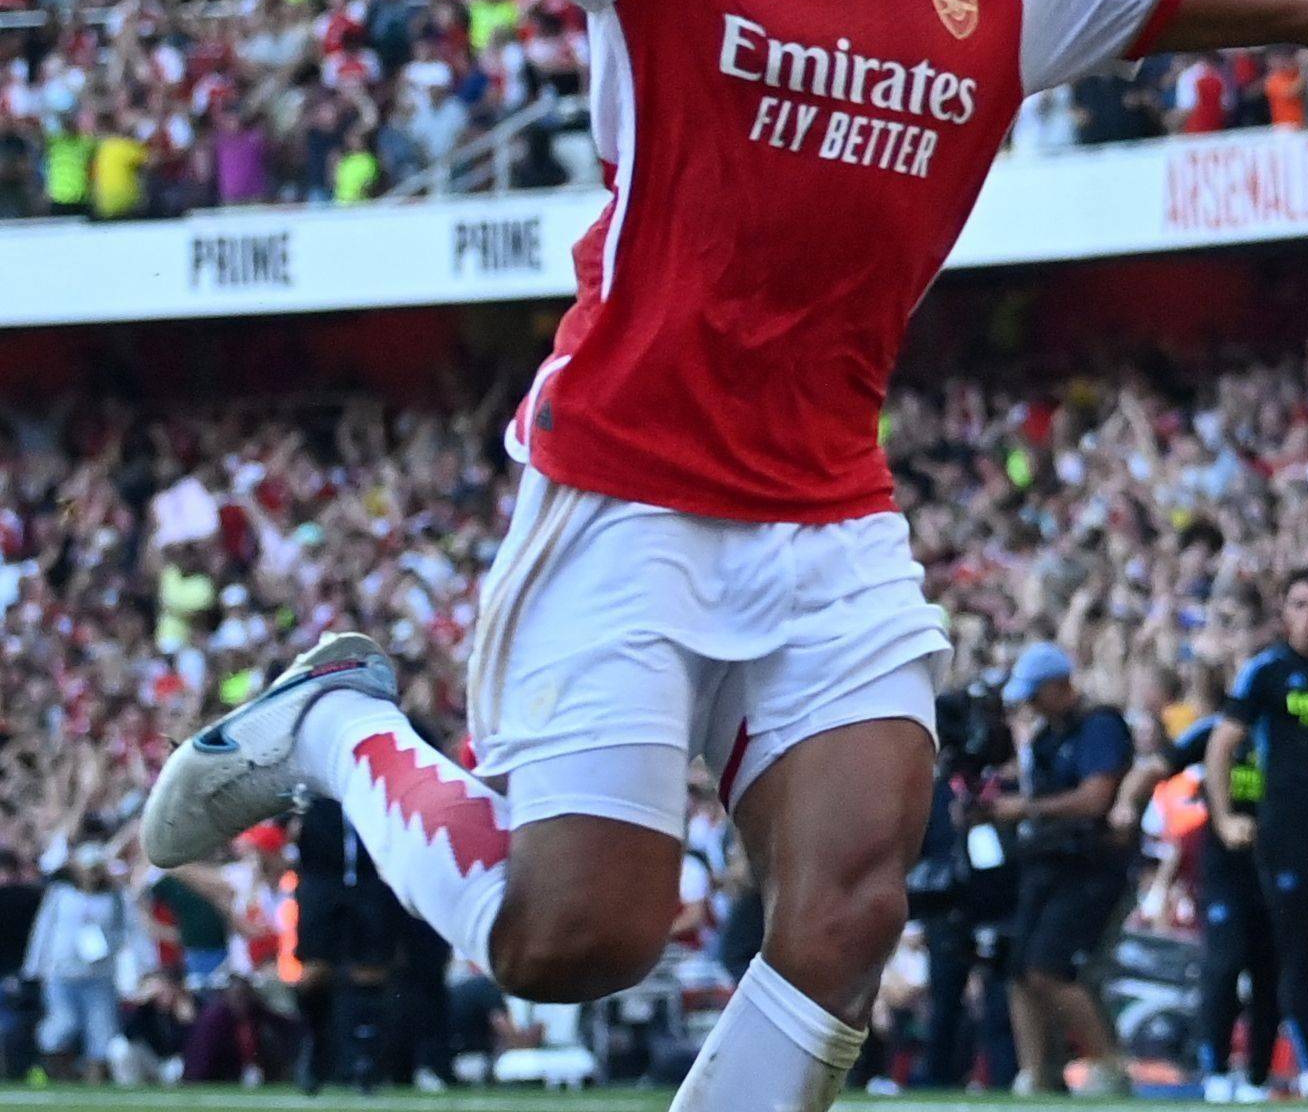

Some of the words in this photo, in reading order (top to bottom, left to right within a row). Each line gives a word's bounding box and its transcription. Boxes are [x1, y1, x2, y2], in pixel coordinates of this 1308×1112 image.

[718, 12, 978, 127] Emirates
[749, 95, 818, 154] FLY
[819, 115, 939, 180] BETTER
[190, 231, 292, 288] PRIME
[454, 216, 542, 276] PRIME
